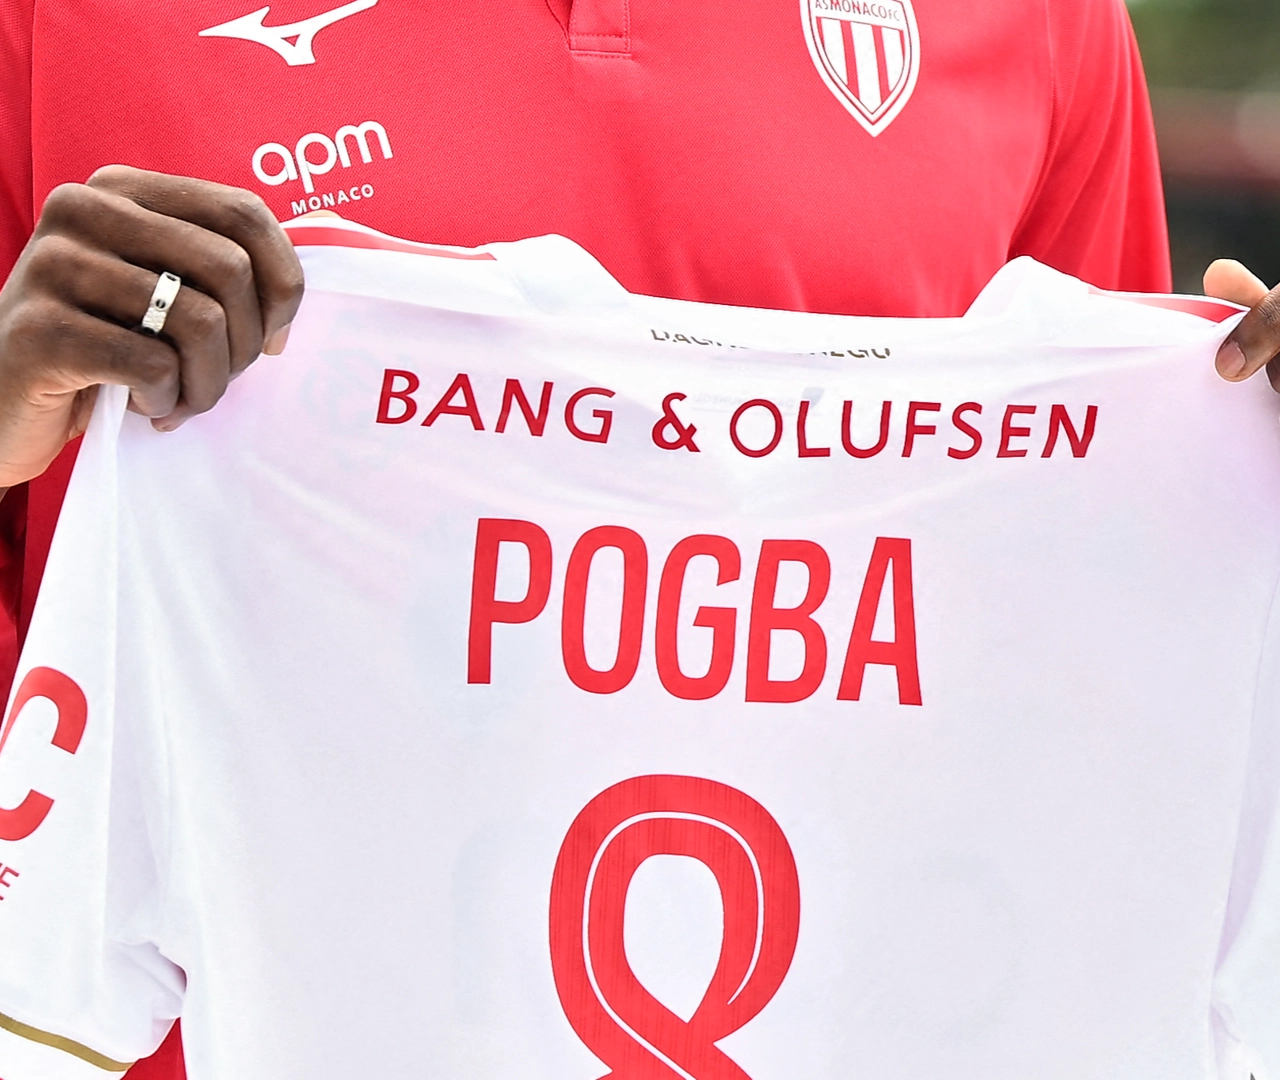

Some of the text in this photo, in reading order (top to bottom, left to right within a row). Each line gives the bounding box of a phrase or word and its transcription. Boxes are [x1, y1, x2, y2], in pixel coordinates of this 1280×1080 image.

[252, 120, 393, 194] apm
[291, 183, 374, 216] MONACO
[375, 368, 1099, 461] BANG & OLUFSEN
[467, 517, 924, 707] POGBA
